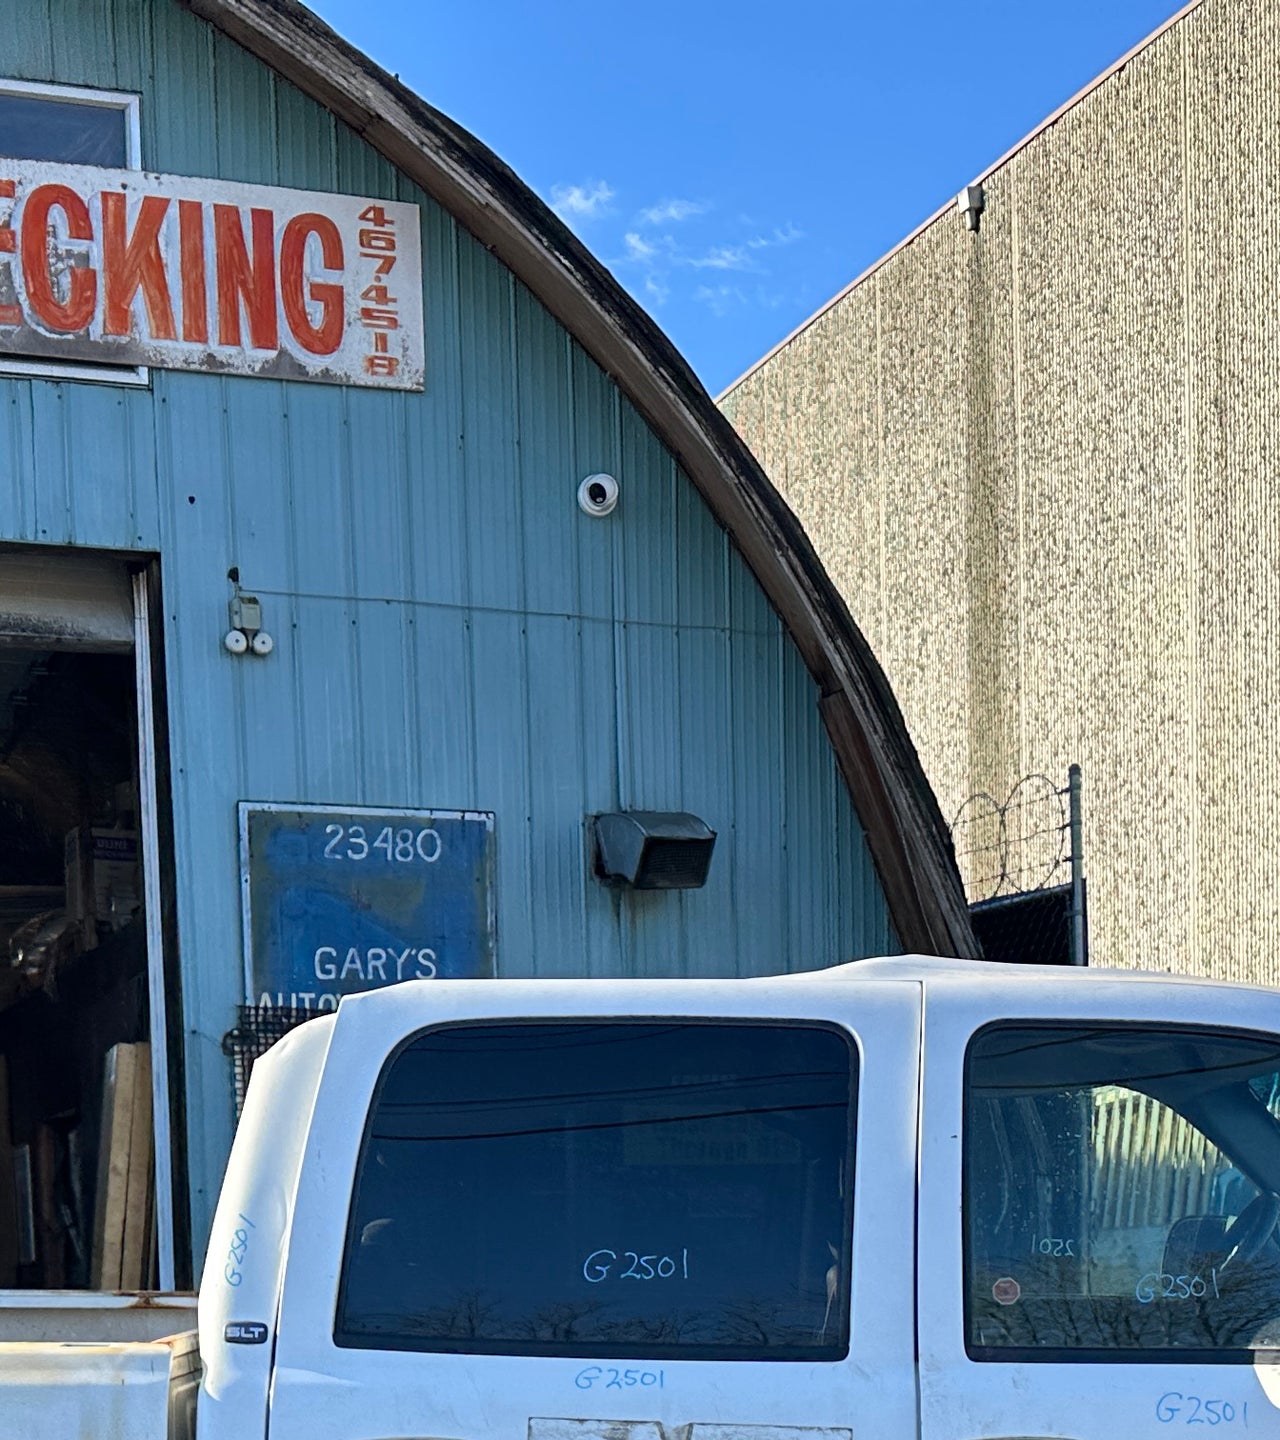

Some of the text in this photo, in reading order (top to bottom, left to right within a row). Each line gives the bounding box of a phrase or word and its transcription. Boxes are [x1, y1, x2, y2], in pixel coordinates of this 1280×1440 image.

[323, 823, 442, 863] 23480
[314, 946, 437, 980] GARY'S
[224, 1212, 256, 1288] G2501
[583, 1248, 689, 1283] G2501
[1135, 1267, 1221, 1303] G2501
[225, 1326, 265, 1339] SLT
[574, 1366, 665, 1389] G2501
[1156, 1392, 1249, 1429] G2501
